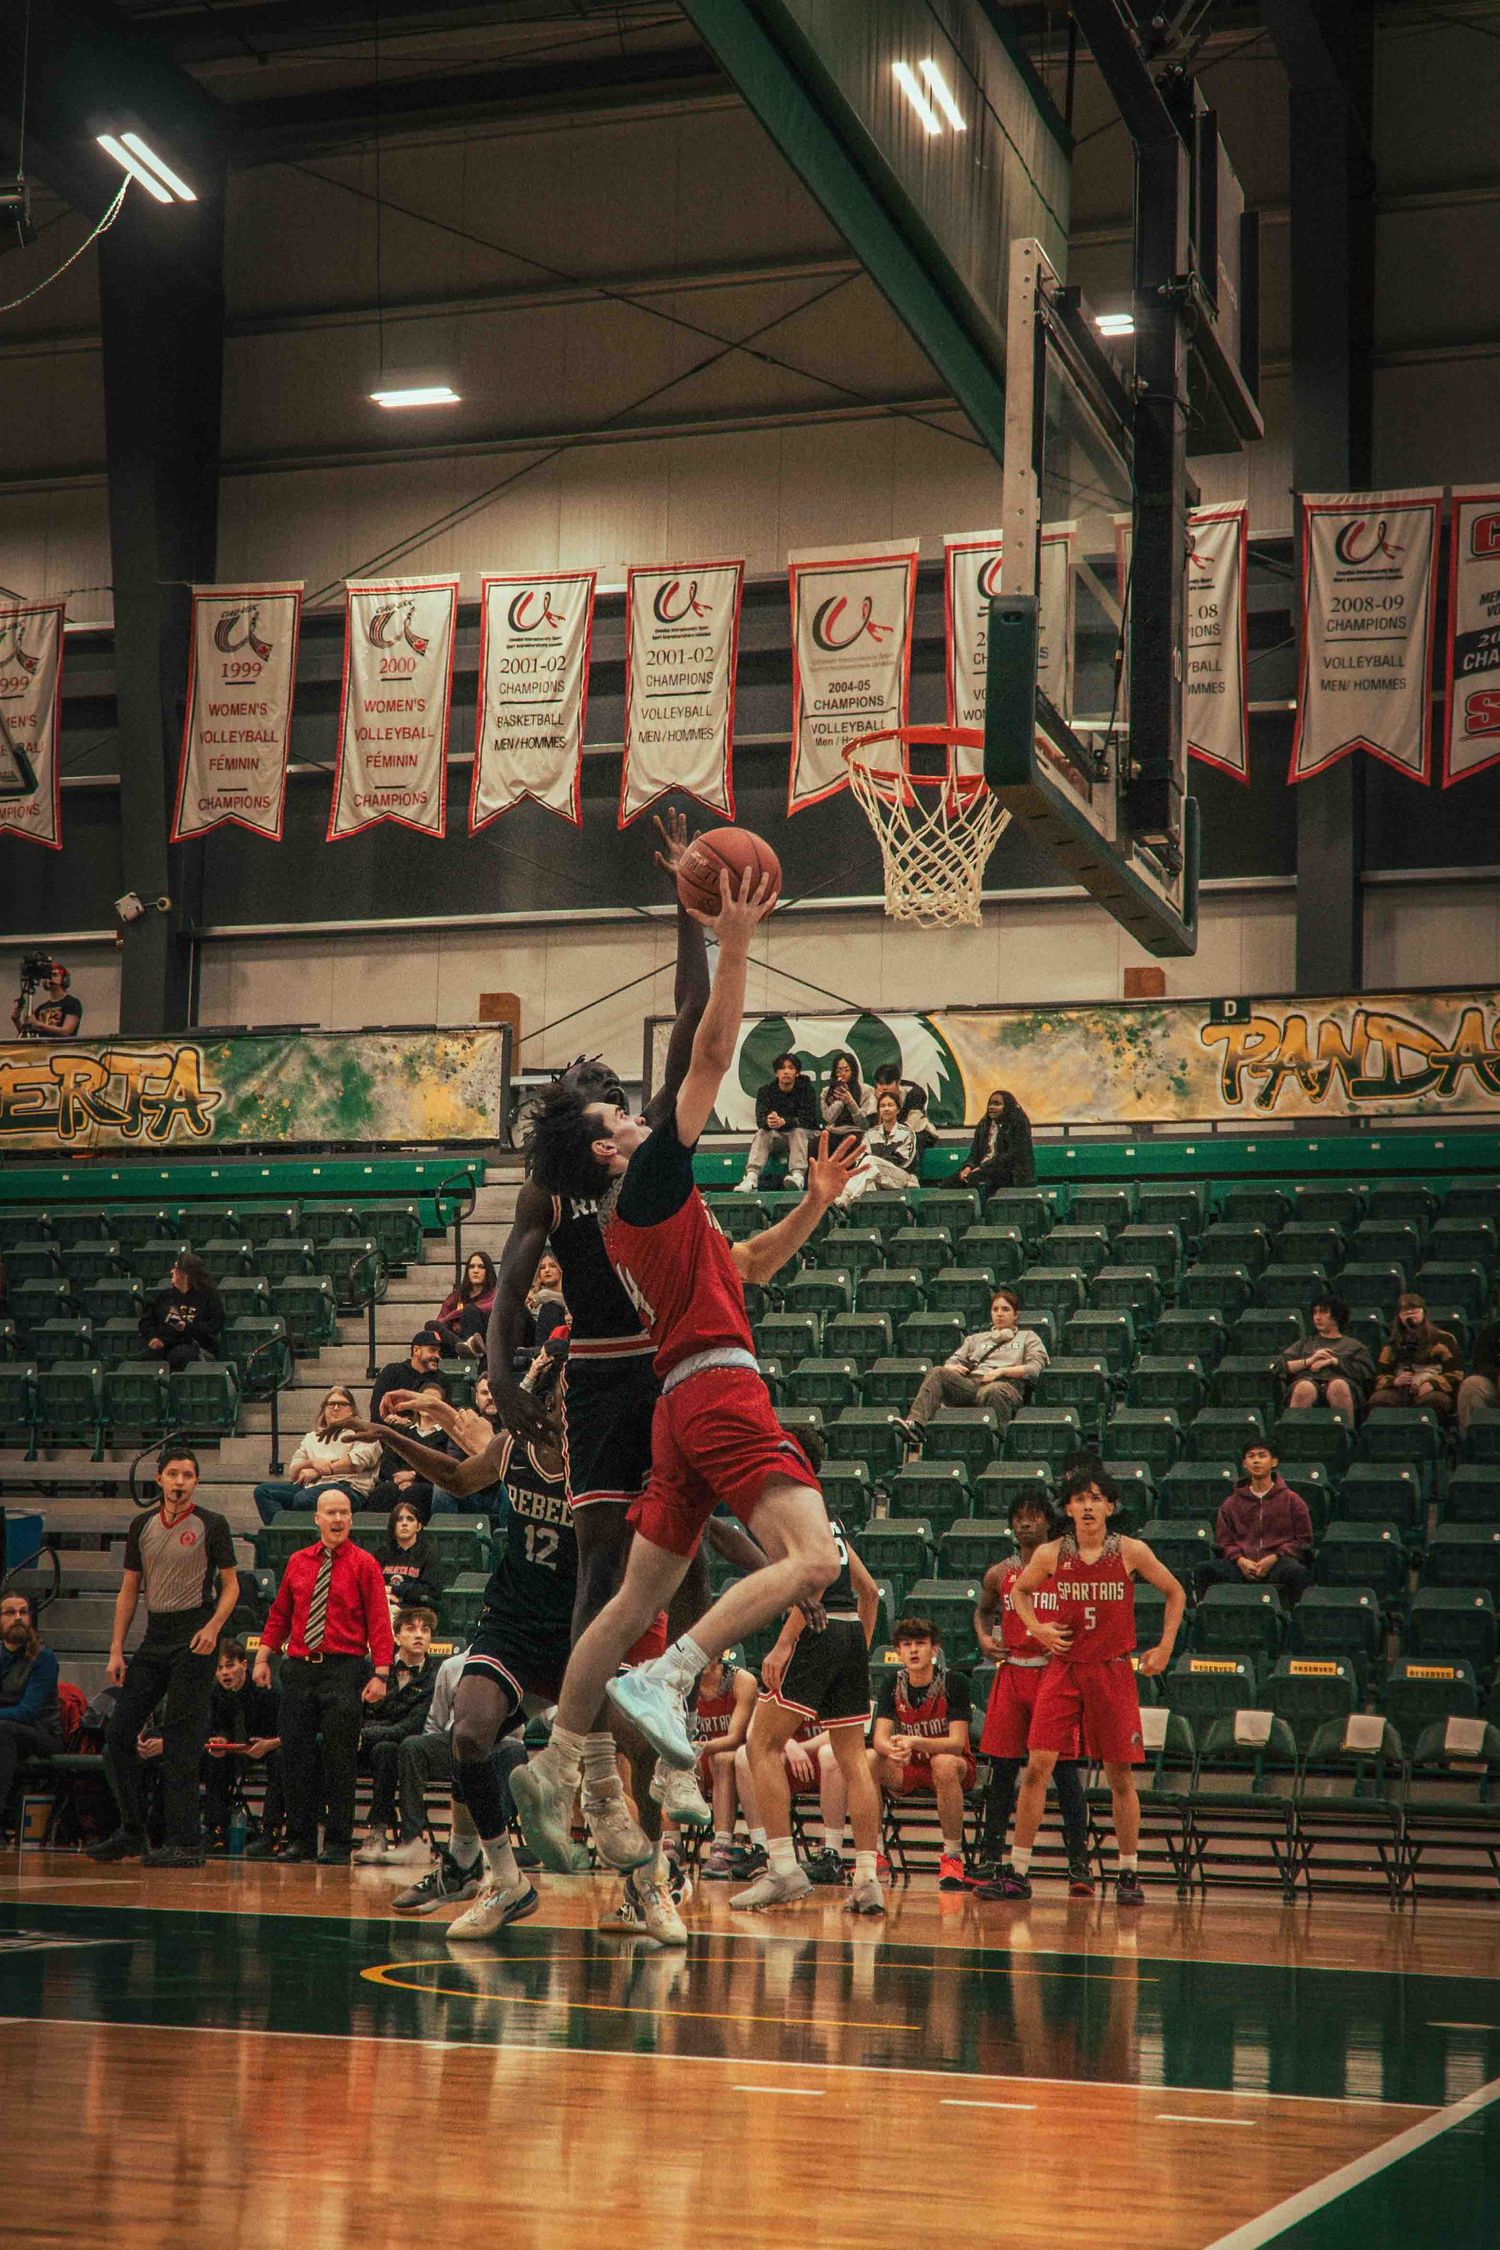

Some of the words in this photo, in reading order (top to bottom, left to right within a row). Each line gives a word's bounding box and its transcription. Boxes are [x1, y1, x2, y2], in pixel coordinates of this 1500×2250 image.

[1330, 595, 1404, 612] 2008-09
[1327, 616, 1407, 632] CHAMPIONS
[646, 647, 714, 666] 2001-02
[1323, 656, 1405, 669] VOLLEYBALL
[221, 663, 262, 679] 1999
[380, 658, 416, 674] 2000
[500, 656, 566, 675] 2001-02
[0, 676, 29, 693] 999
[500, 680, 565, 695] CHAMPIONS
[646, 672, 714, 687] CHAMPIONS
[829, 680, 870, 694] 2004-05
[208, 703, 268, 717] WOMEN'S
[364, 700, 426, 713] WOMEN'S
[814, 696, 884, 711] CHAMPIONS
[497, 713, 564, 728] BASKETBALL
[641, 706, 712, 720] VOLLEYBALL
[356, 727, 434, 741] VOLLEYBALL
[812, 720, 885, 735] VOLLEYBALL
[200, 730, 279, 744] VOLLEYBALL
[209, 754, 260, 771] FÉMININ
[366, 752, 418, 768] FÉMININ
[198, 796, 271, 811] CHAMPIONS
[354, 792, 428, 807] CHAMPIONS
[1224, 1000, 1237, 1017] D
[1200, 1007, 1500, 1111] PANDA
[0, 1047, 222, 1142] ERTA
[507, 1482, 575, 1528] REBEL
[525, 1524, 559, 1570] 12
[1057, 1581, 1124, 1601] SPARTANS
[1084, 1606, 1096, 1631] 5
